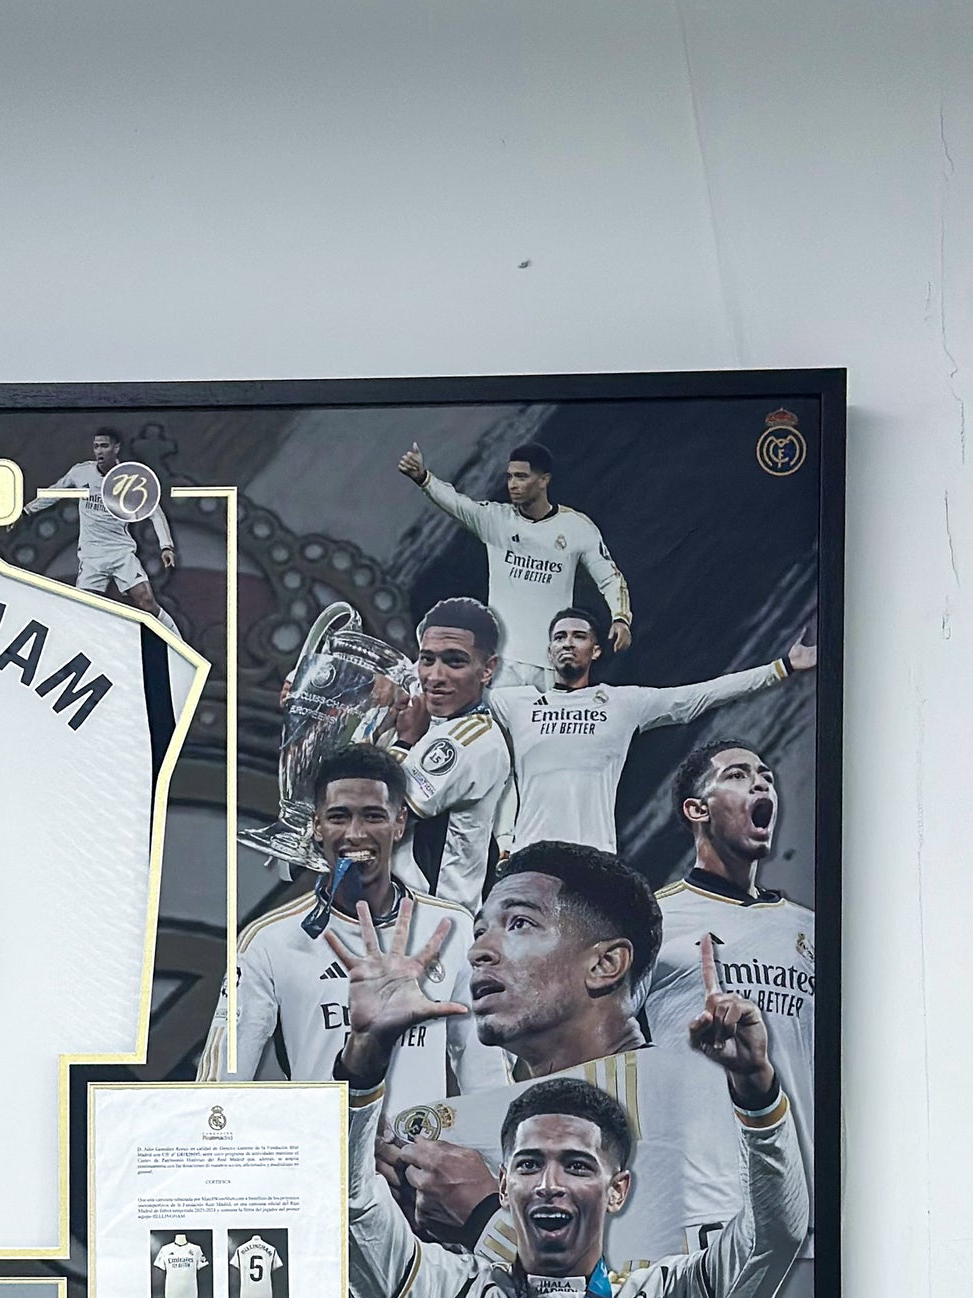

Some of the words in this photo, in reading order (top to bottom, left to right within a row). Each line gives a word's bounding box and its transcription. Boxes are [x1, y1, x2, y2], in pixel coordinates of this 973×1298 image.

[504, 549, 564, 573] Emirates
[524, 569, 553, 584] BETTER
[531, 707, 608, 723] Emirates
[540, 722, 557, 735] FLY
[559, 722, 597, 735] BETTER
[715, 958, 816, 997] mirates
[757, 989, 804, 1019] BETTER
[249, 1254, 264, 1282] 5
